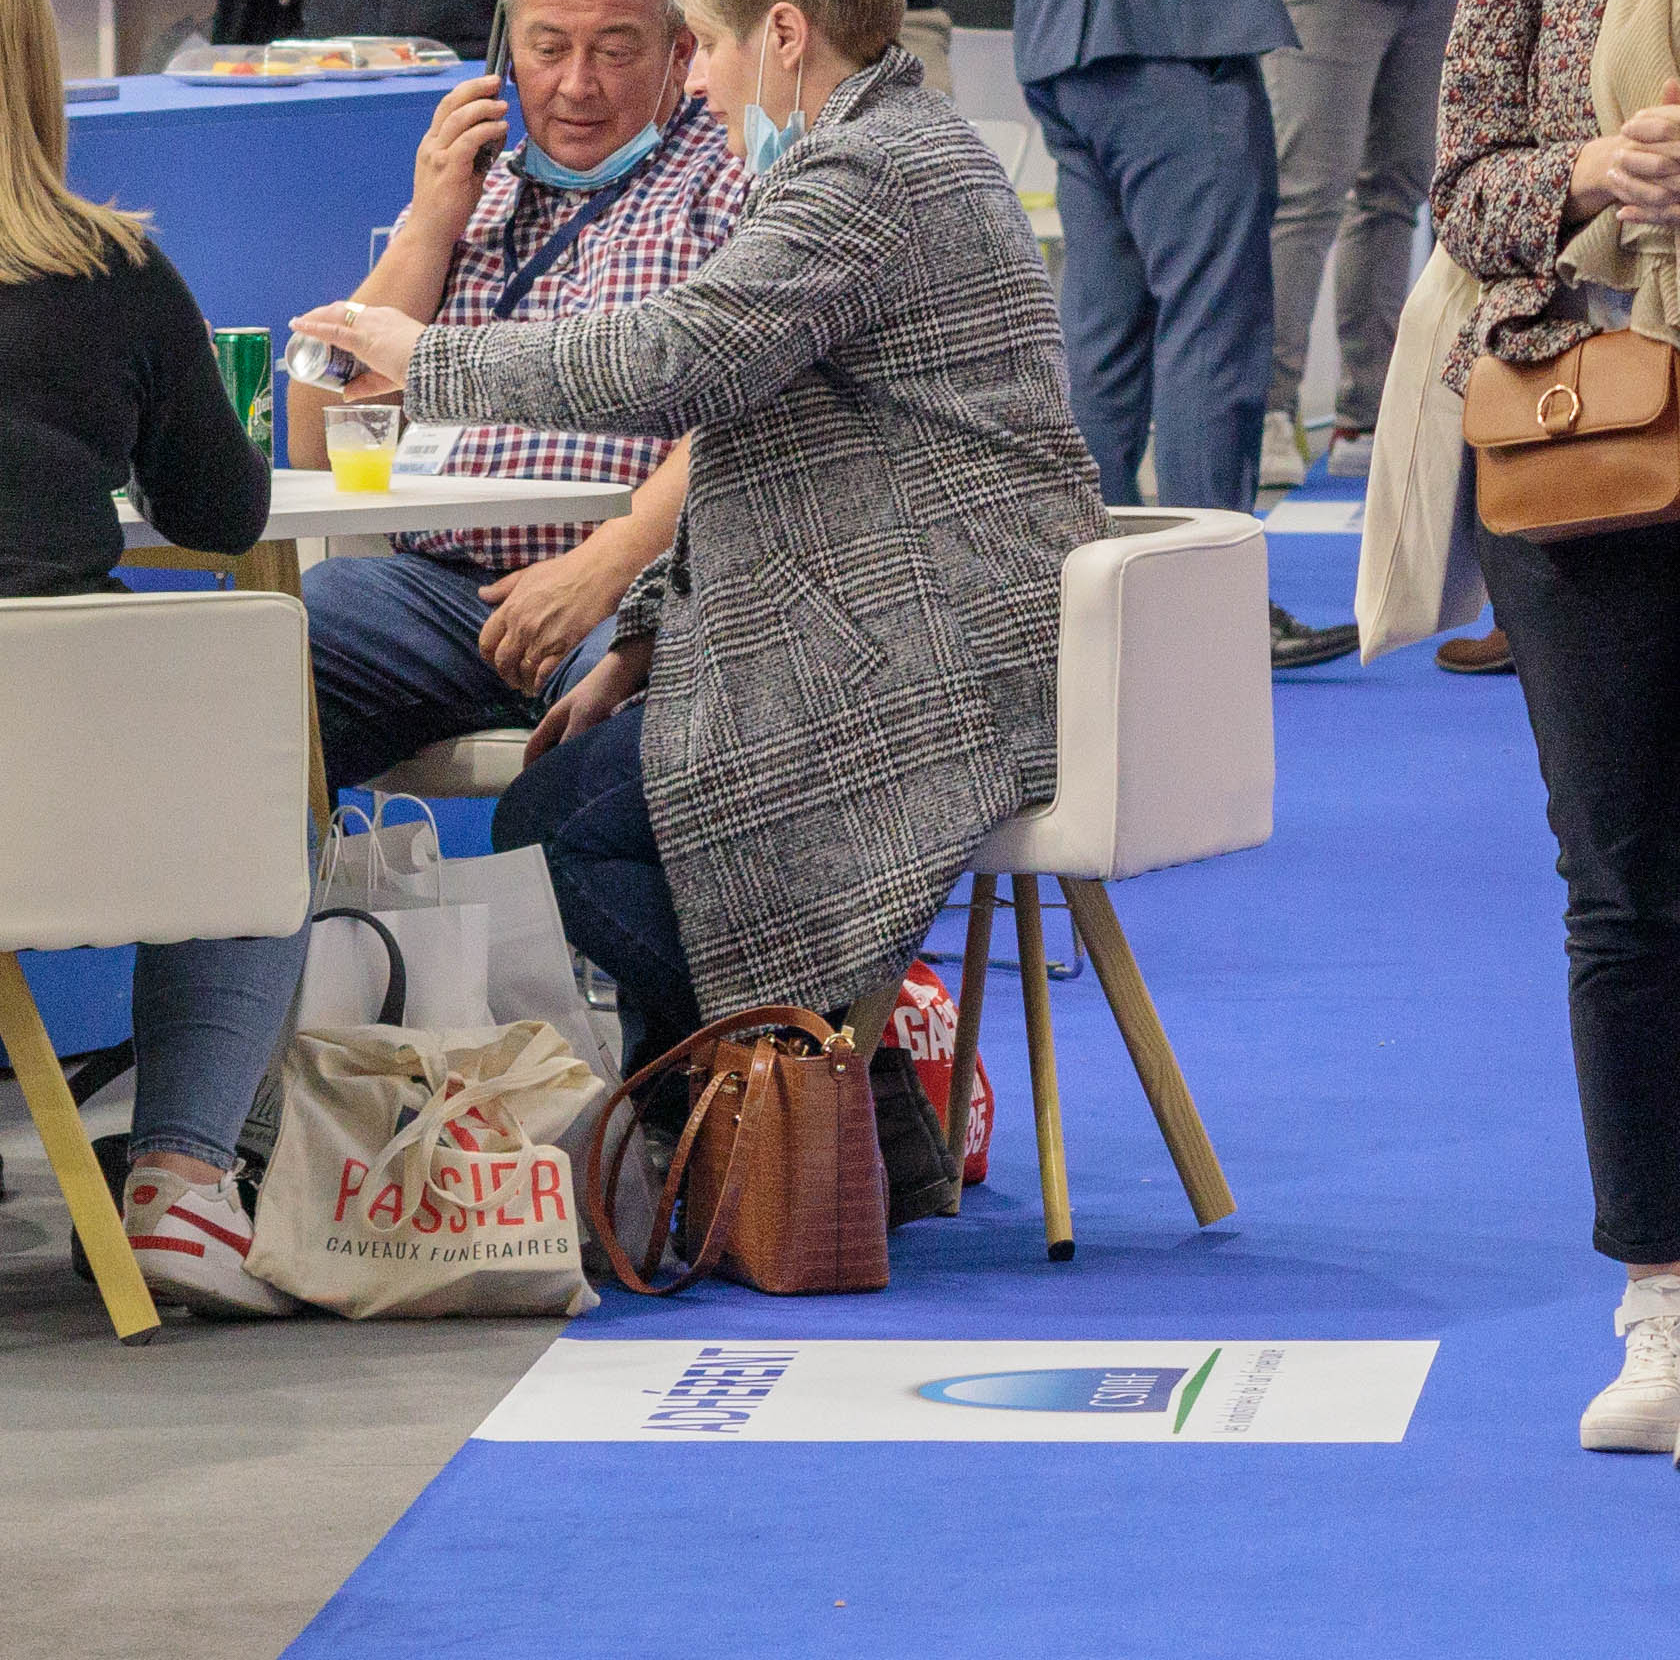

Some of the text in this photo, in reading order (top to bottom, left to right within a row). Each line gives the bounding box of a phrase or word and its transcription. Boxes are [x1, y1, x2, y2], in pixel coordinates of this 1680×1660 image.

[333, 1157, 570, 1235] PASSIER
[325, 1235, 570, 1265] CAVEAUX FUNÉRAIRES
[640, 1347, 800, 1435] ADHÉRENT
